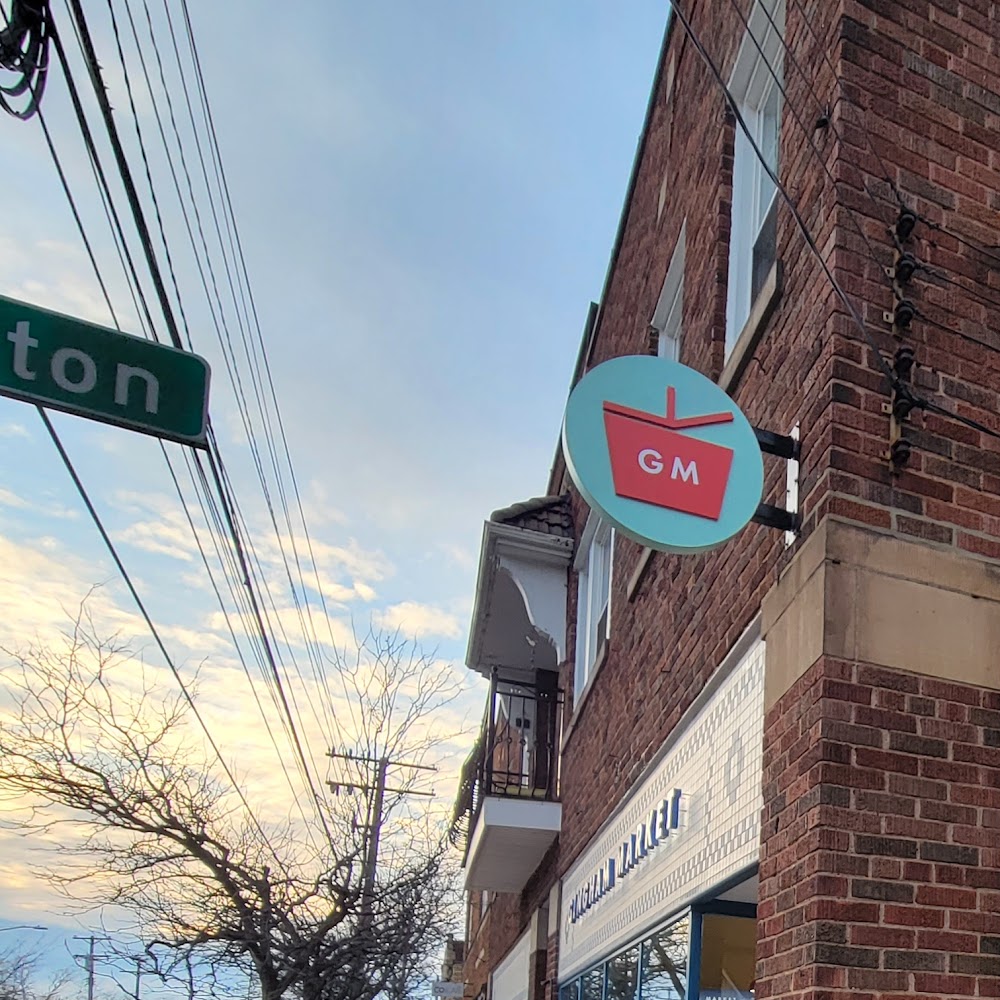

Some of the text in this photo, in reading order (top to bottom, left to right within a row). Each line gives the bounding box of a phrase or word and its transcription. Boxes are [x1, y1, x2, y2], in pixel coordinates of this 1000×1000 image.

[7, 320, 160, 415] ton
[637, 448, 700, 486] GM
[617, 788, 682, 878] MARKET
